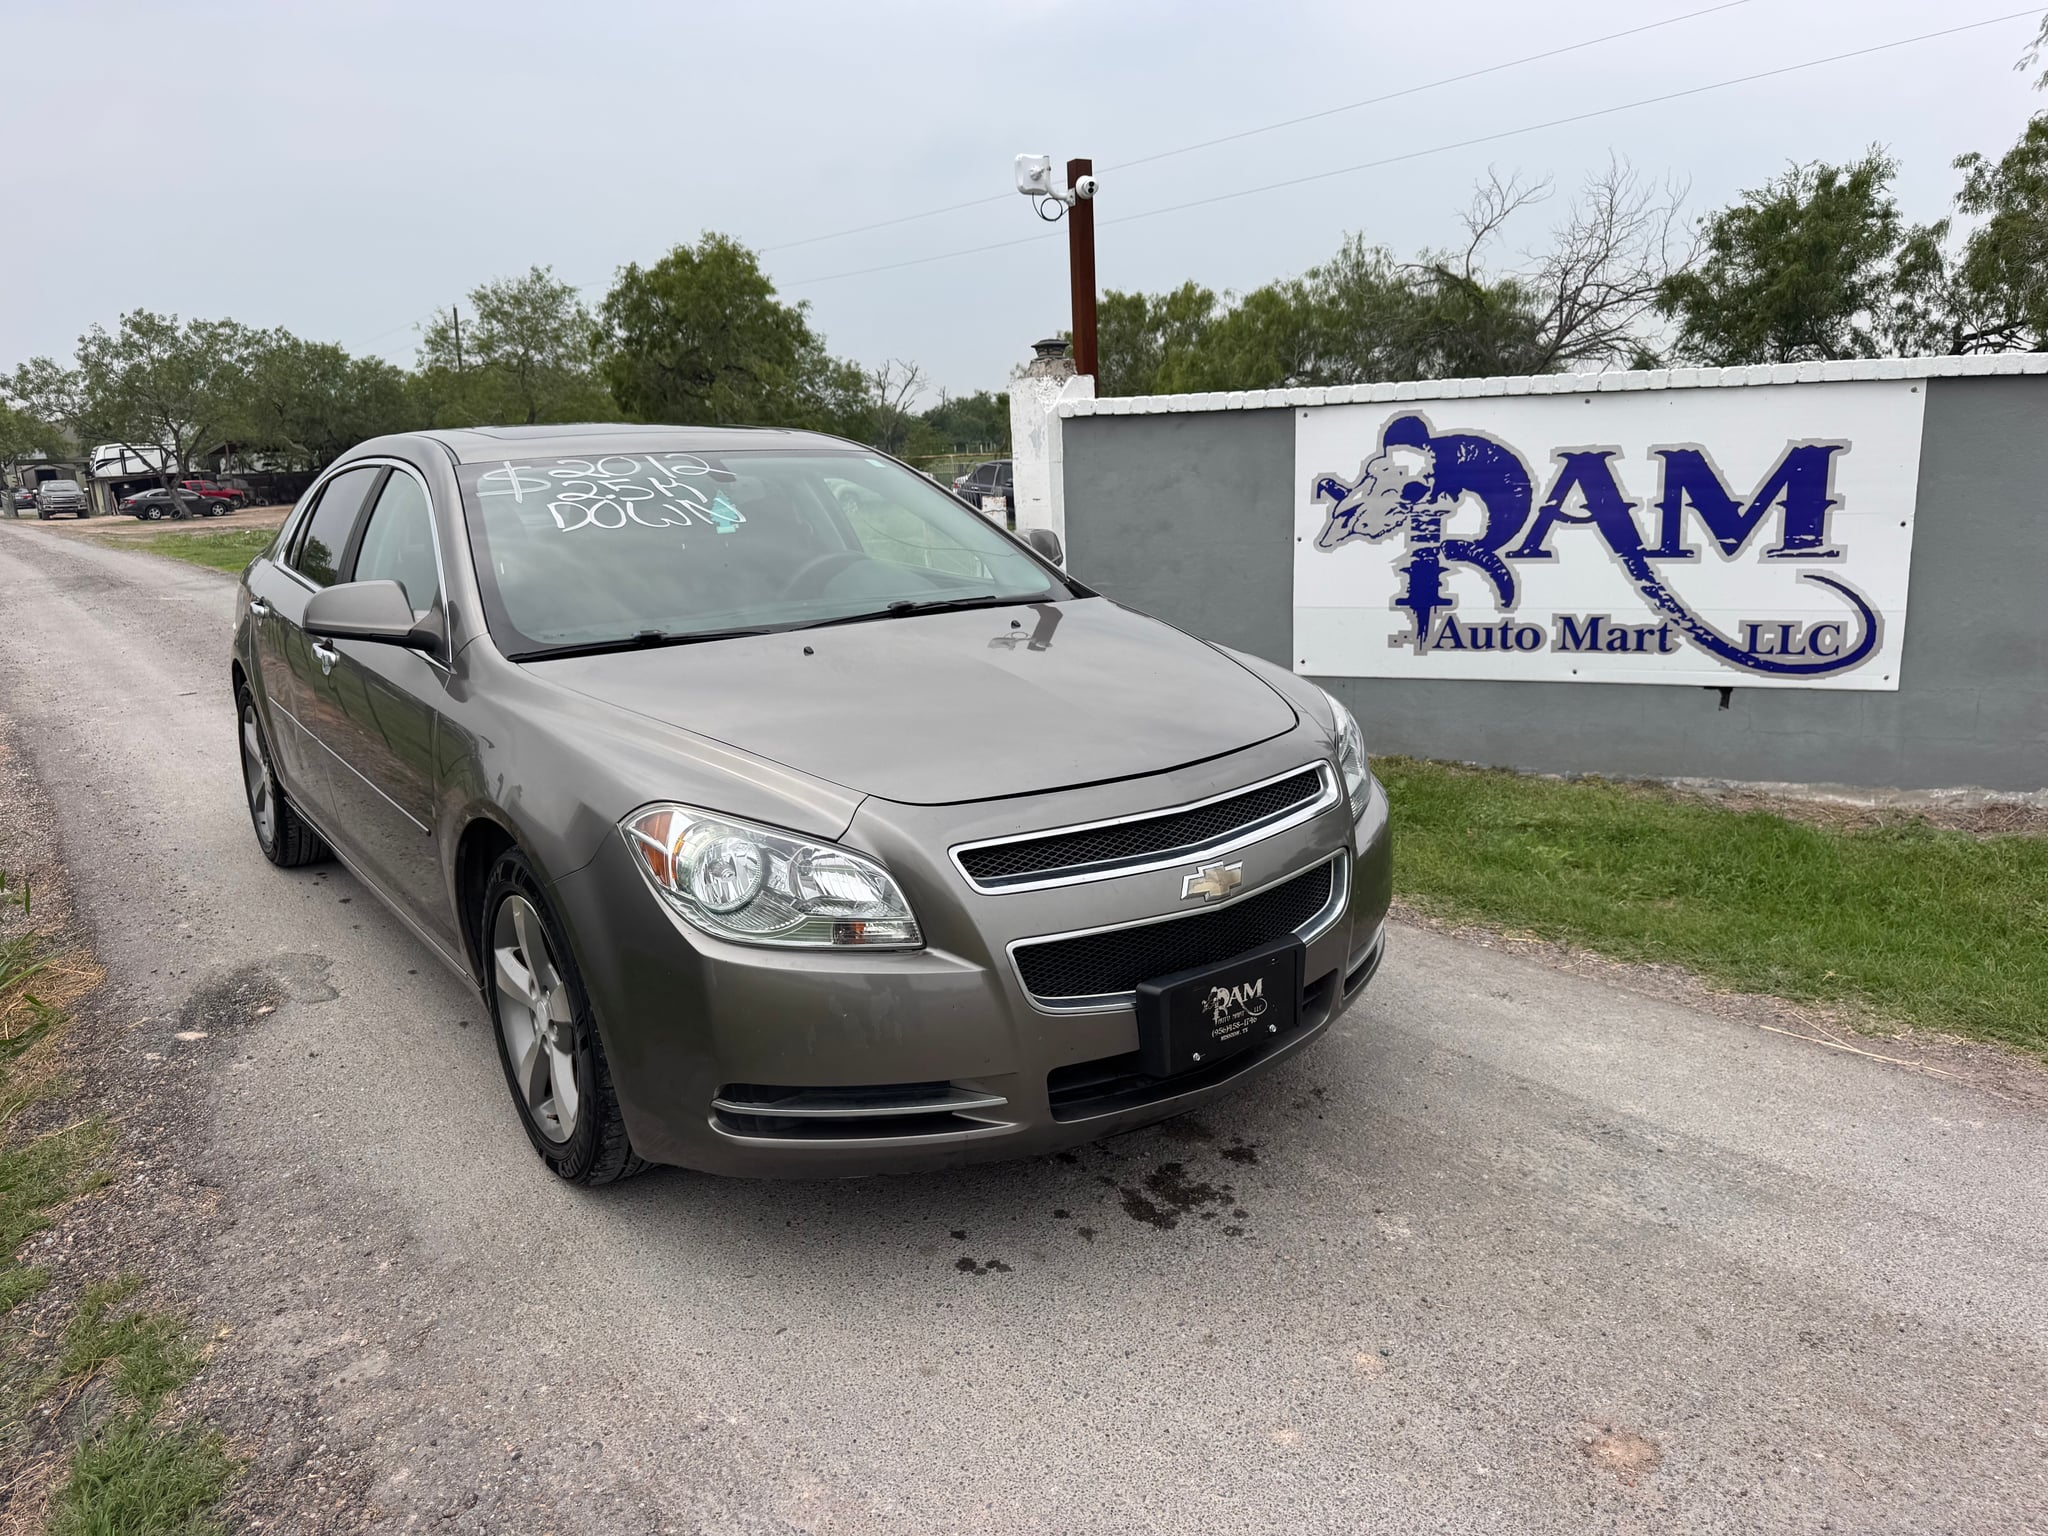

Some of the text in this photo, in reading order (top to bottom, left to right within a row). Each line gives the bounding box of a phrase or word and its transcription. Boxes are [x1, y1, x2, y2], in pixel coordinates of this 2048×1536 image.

[547, 453, 738, 480] 2012
[546, 497, 747, 532] DOWN
[1380, 415, 1848, 645] RAM
[1433, 615, 1842, 657] Auto Mart LLC
[1209, 977, 1264, 1018] RAM
